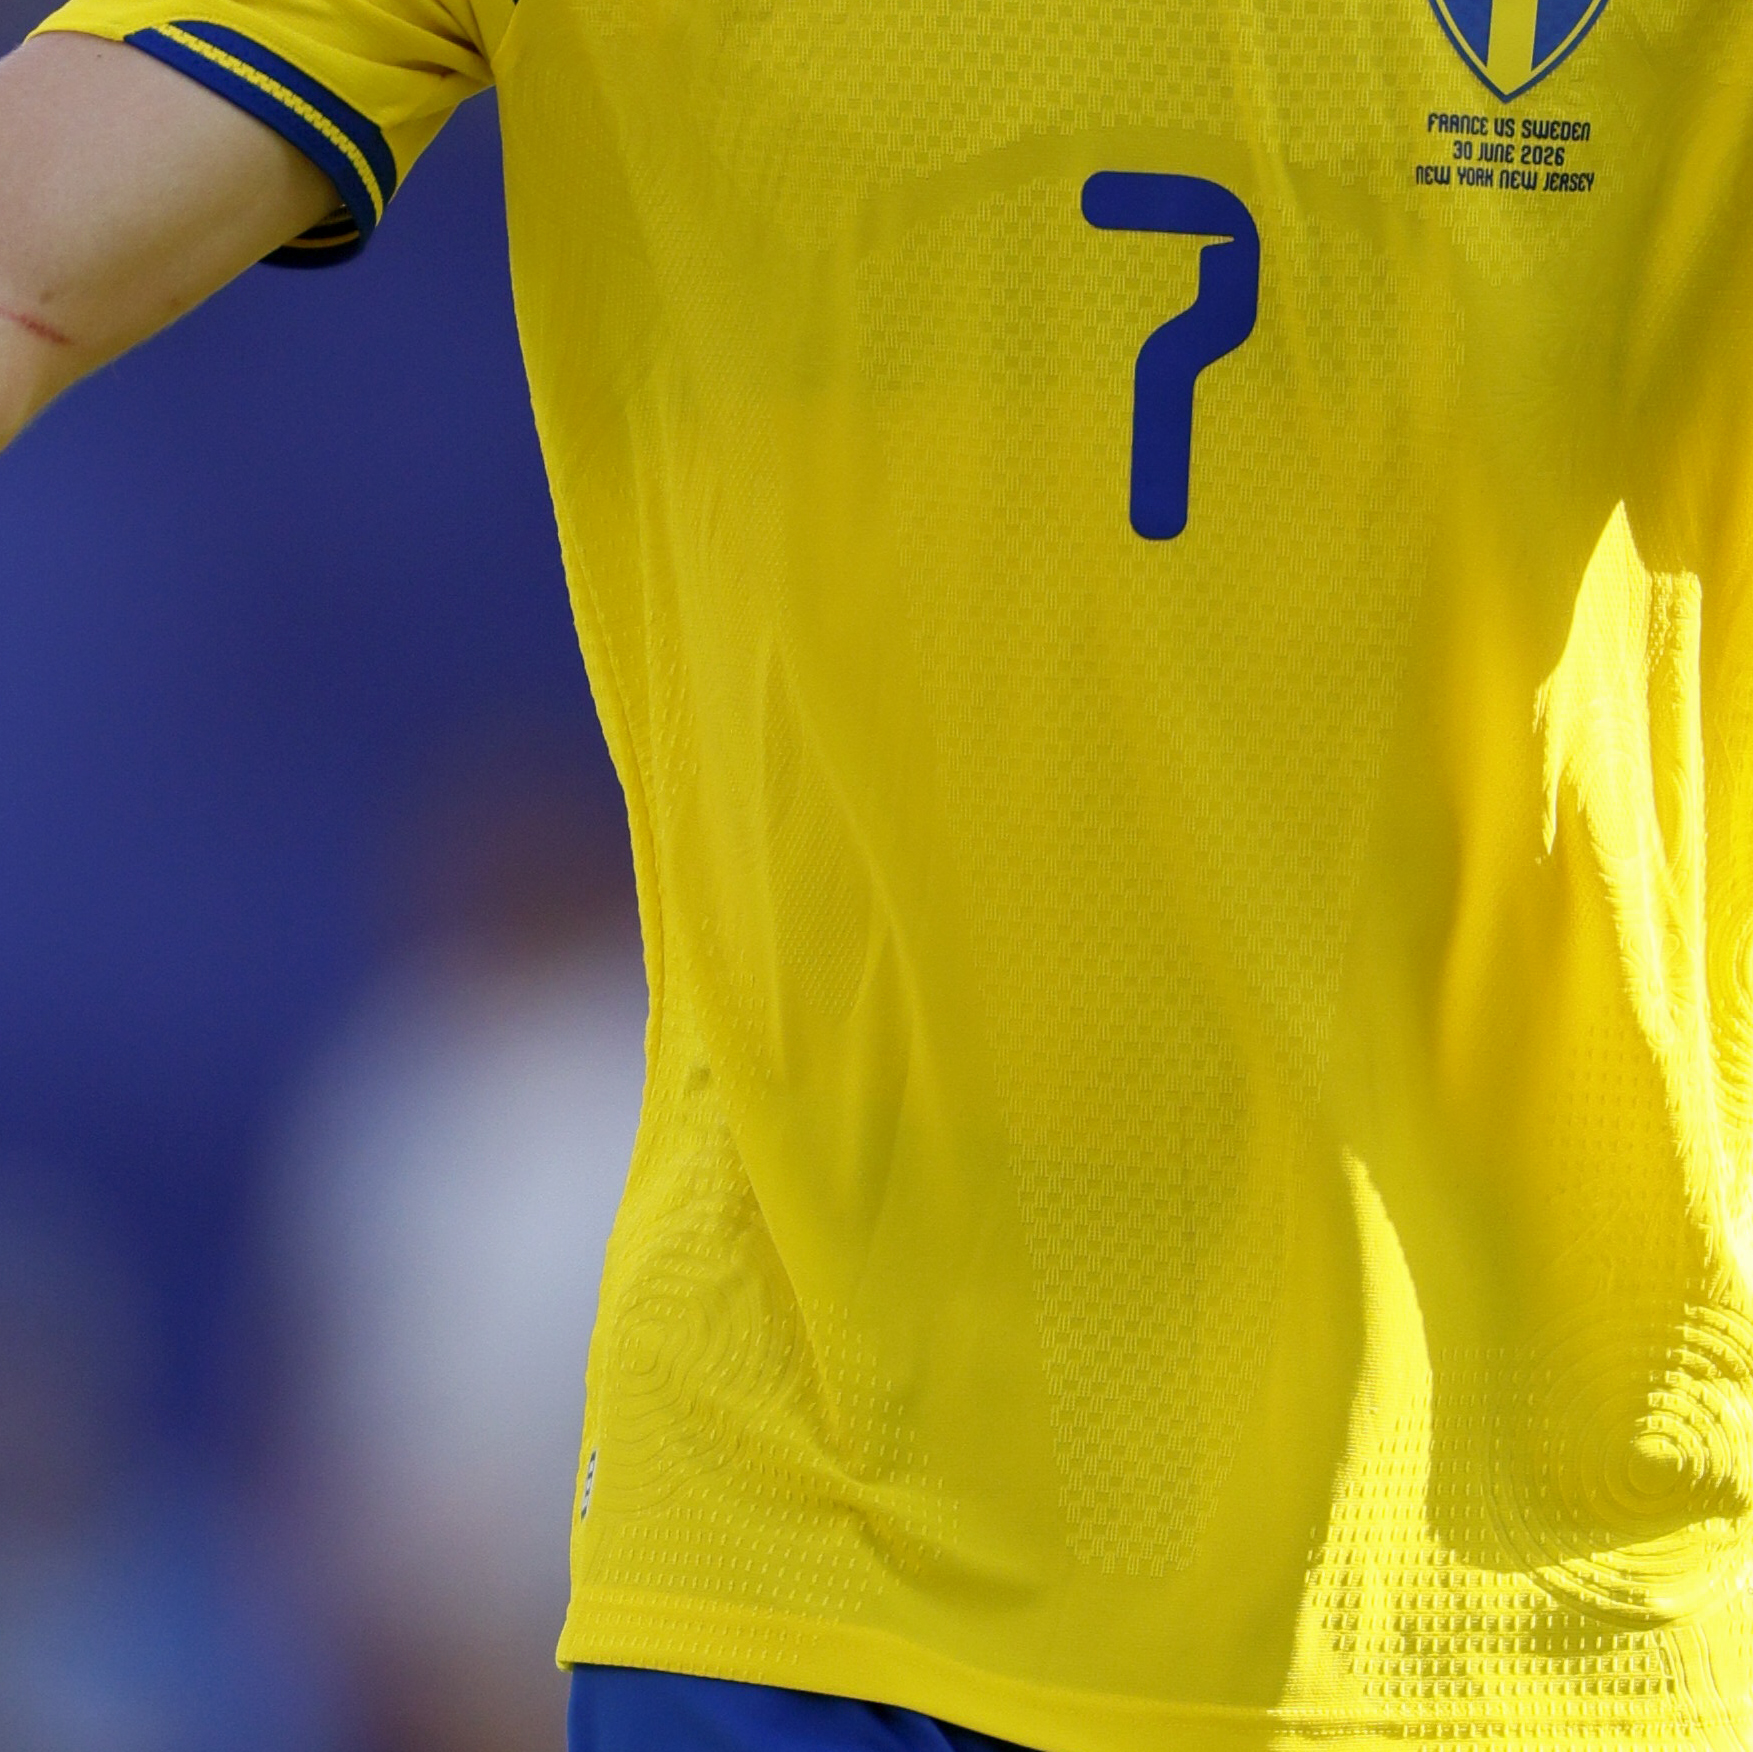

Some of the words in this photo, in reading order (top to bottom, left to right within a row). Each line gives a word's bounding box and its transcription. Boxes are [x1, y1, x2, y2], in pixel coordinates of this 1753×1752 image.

[1427, 113, 1488, 136] FRANCE
[1521, 119, 1592, 141] SWEDEN
[1453, 140, 1473, 160] 30
[1477, 142, 1515, 164] JUNE
[1520, 146, 1566, 167] 2026
[1416, 165, 1451, 185] NEW
[1457, 166, 1494, 187] YORK
[1499, 169, 1538, 191] NEW
[1543, 172, 1595, 192] JERSEY
[1081, 170, 1260, 540] 7
